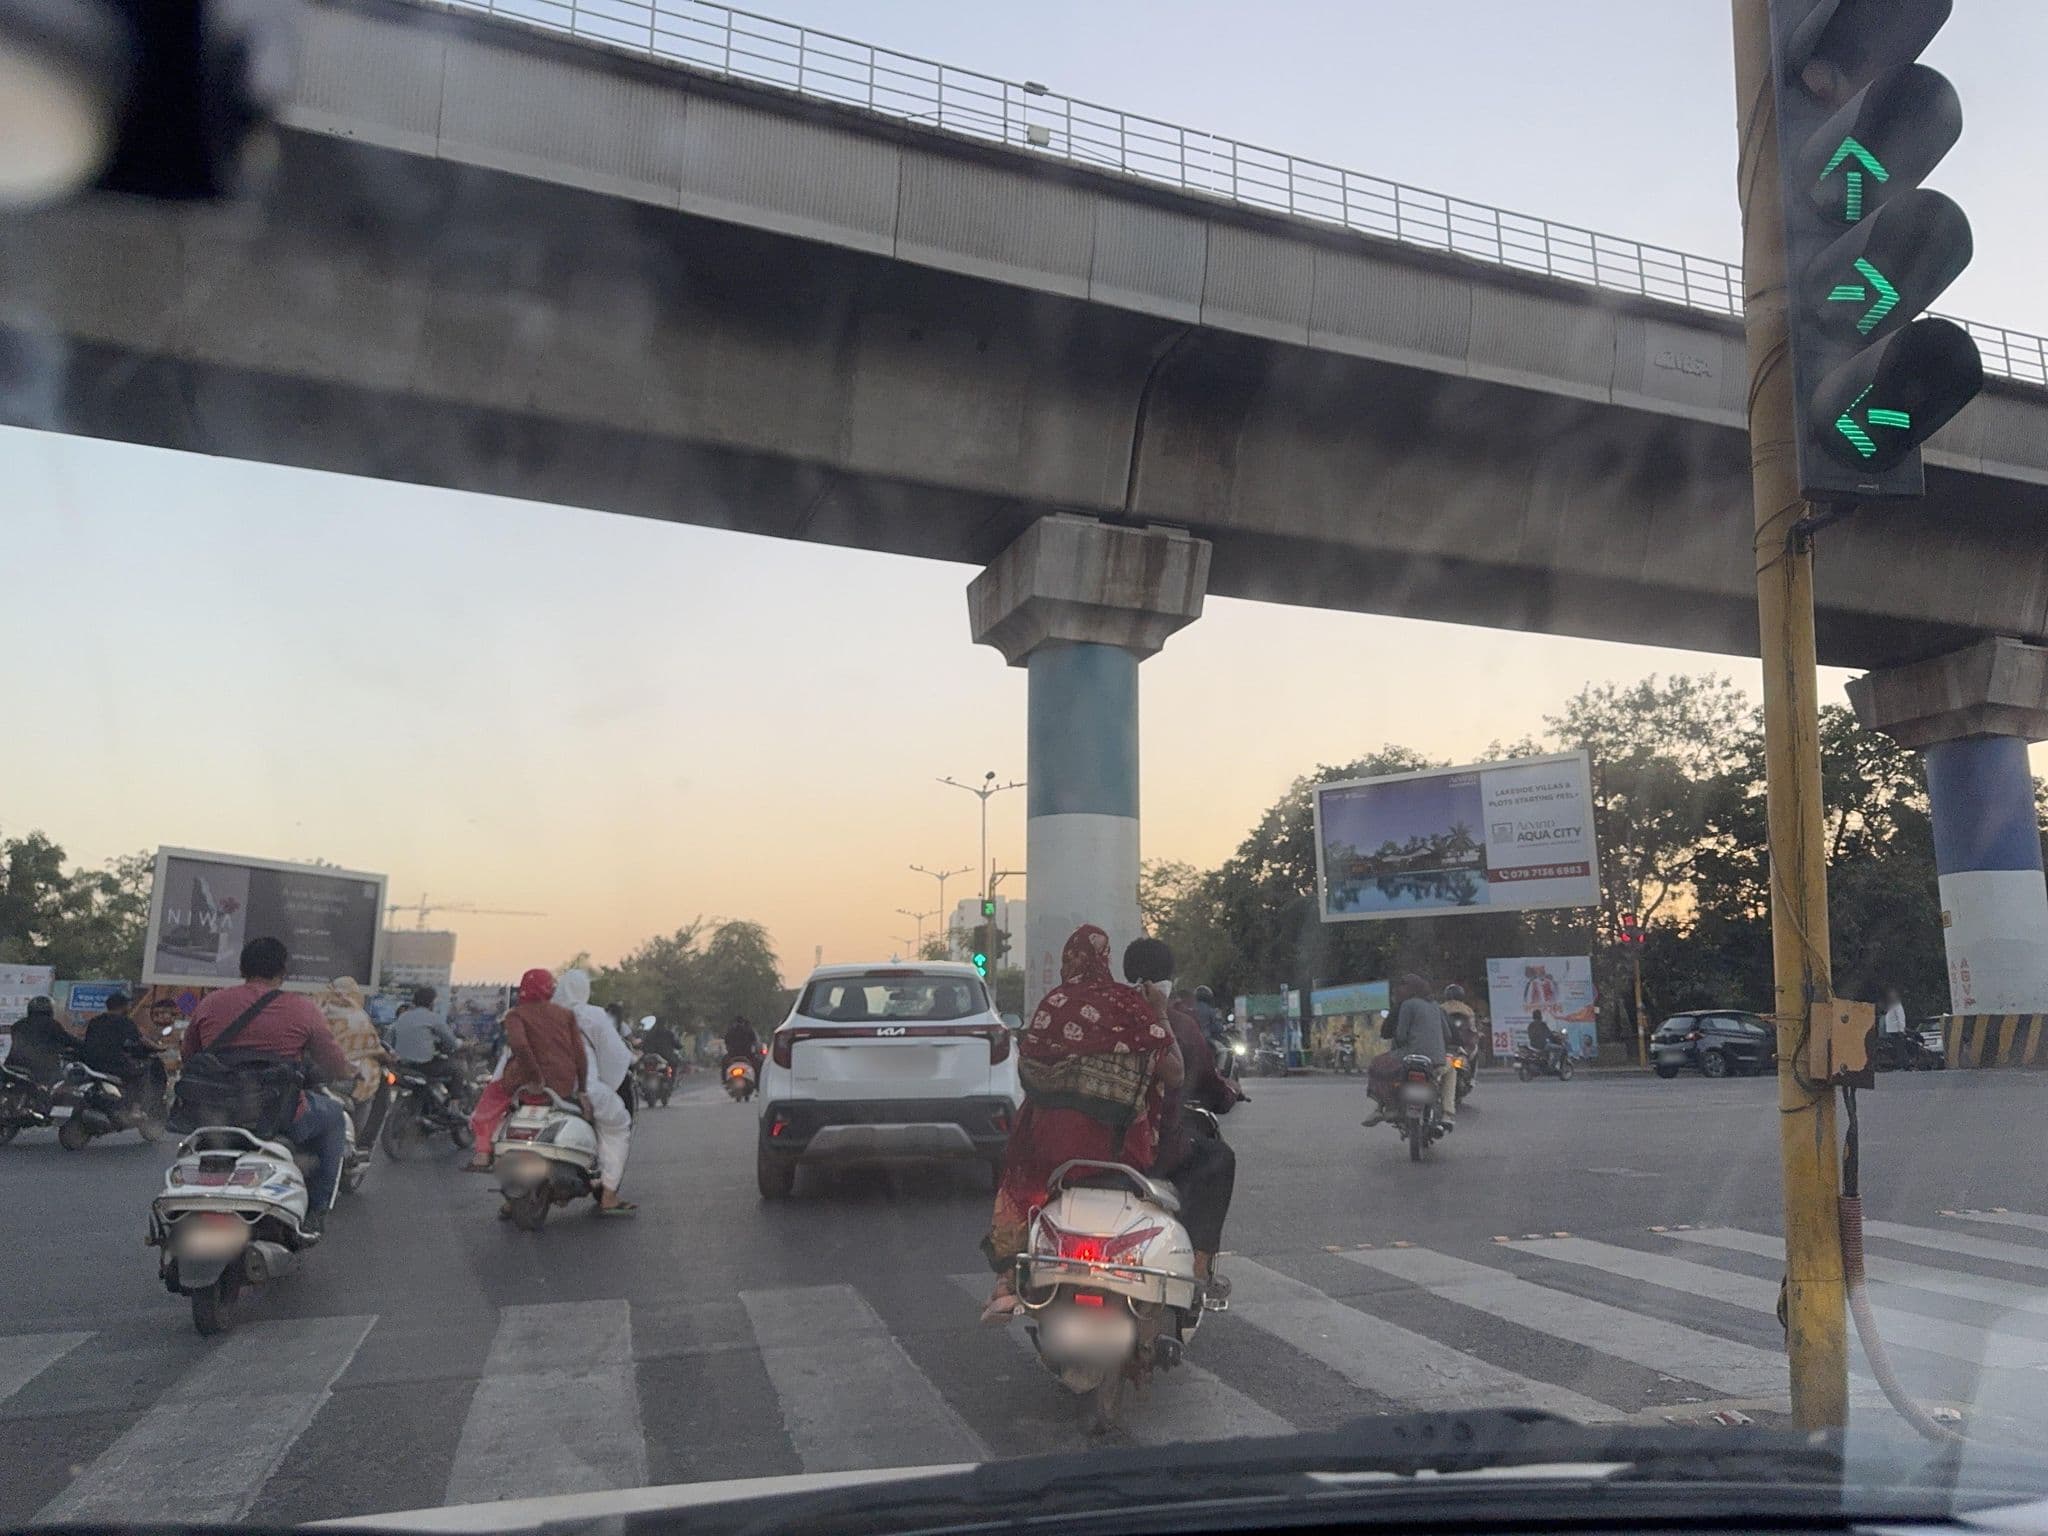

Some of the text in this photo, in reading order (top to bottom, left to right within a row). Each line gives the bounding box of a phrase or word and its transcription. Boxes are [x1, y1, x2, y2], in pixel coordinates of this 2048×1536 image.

[1535, 782, 1564, 792] VILLAS
[1489, 798, 1513, 807] PLOTS
[1517, 827, 1582, 842] AQUA CITY
[167, 907, 233, 929] NIWA
[877, 1027, 905, 1036] KIA
[1493, 1032, 1508, 1048] 28
